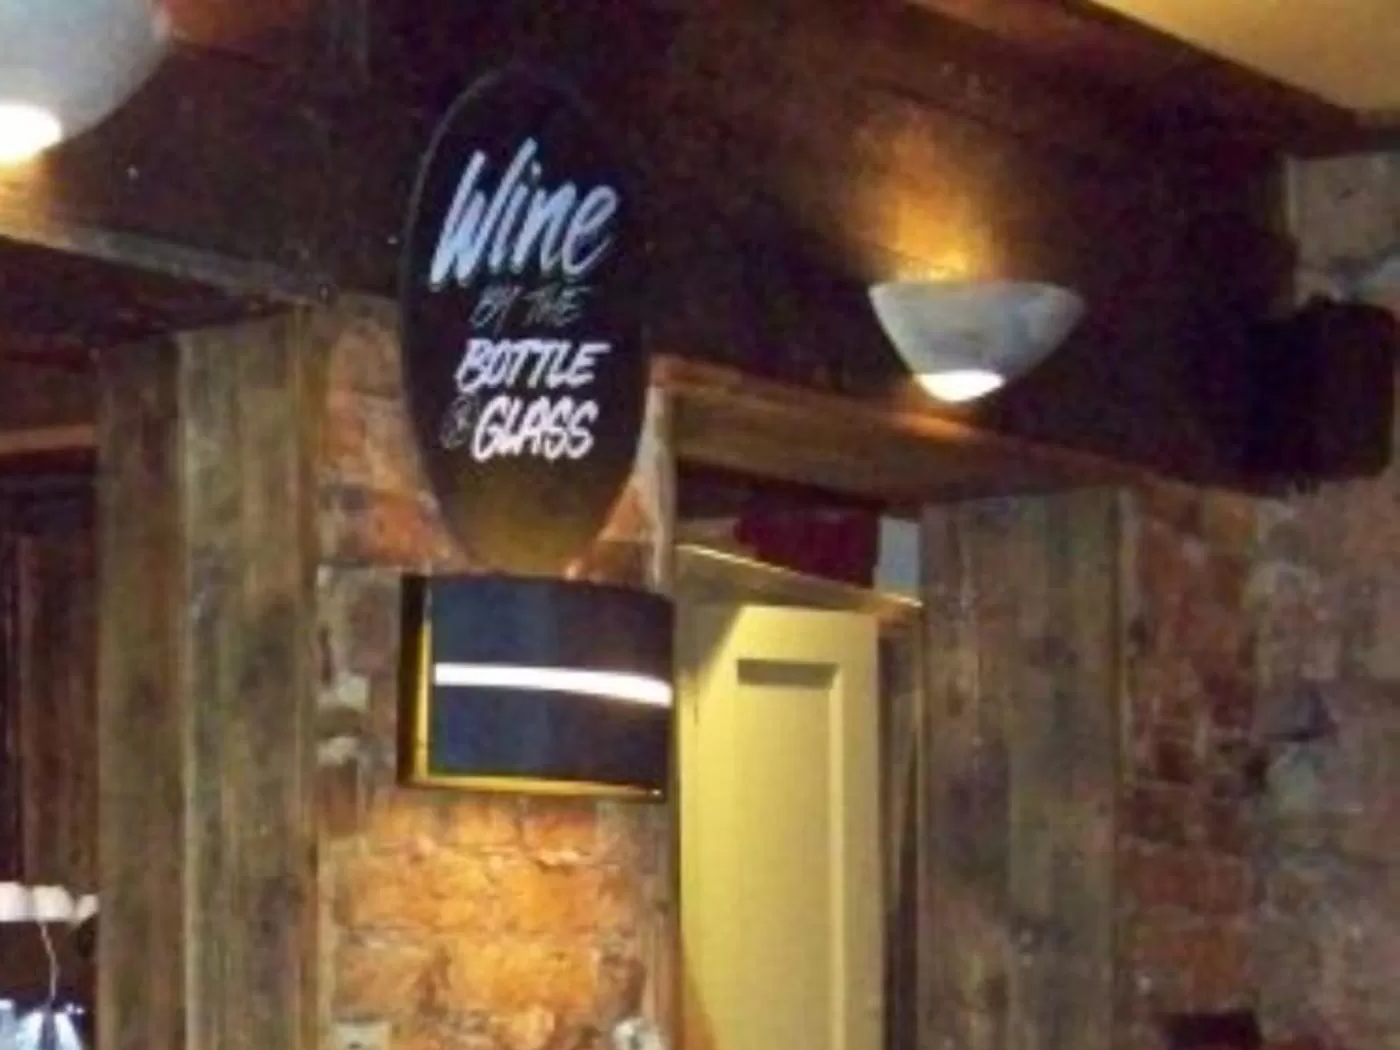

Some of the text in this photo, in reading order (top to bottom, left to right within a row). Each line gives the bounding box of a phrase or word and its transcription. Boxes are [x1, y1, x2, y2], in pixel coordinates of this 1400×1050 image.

[429, 136, 622, 291] Wine
[454, 337, 611, 393] BOTTLE
[471, 395, 599, 463] GLASS
